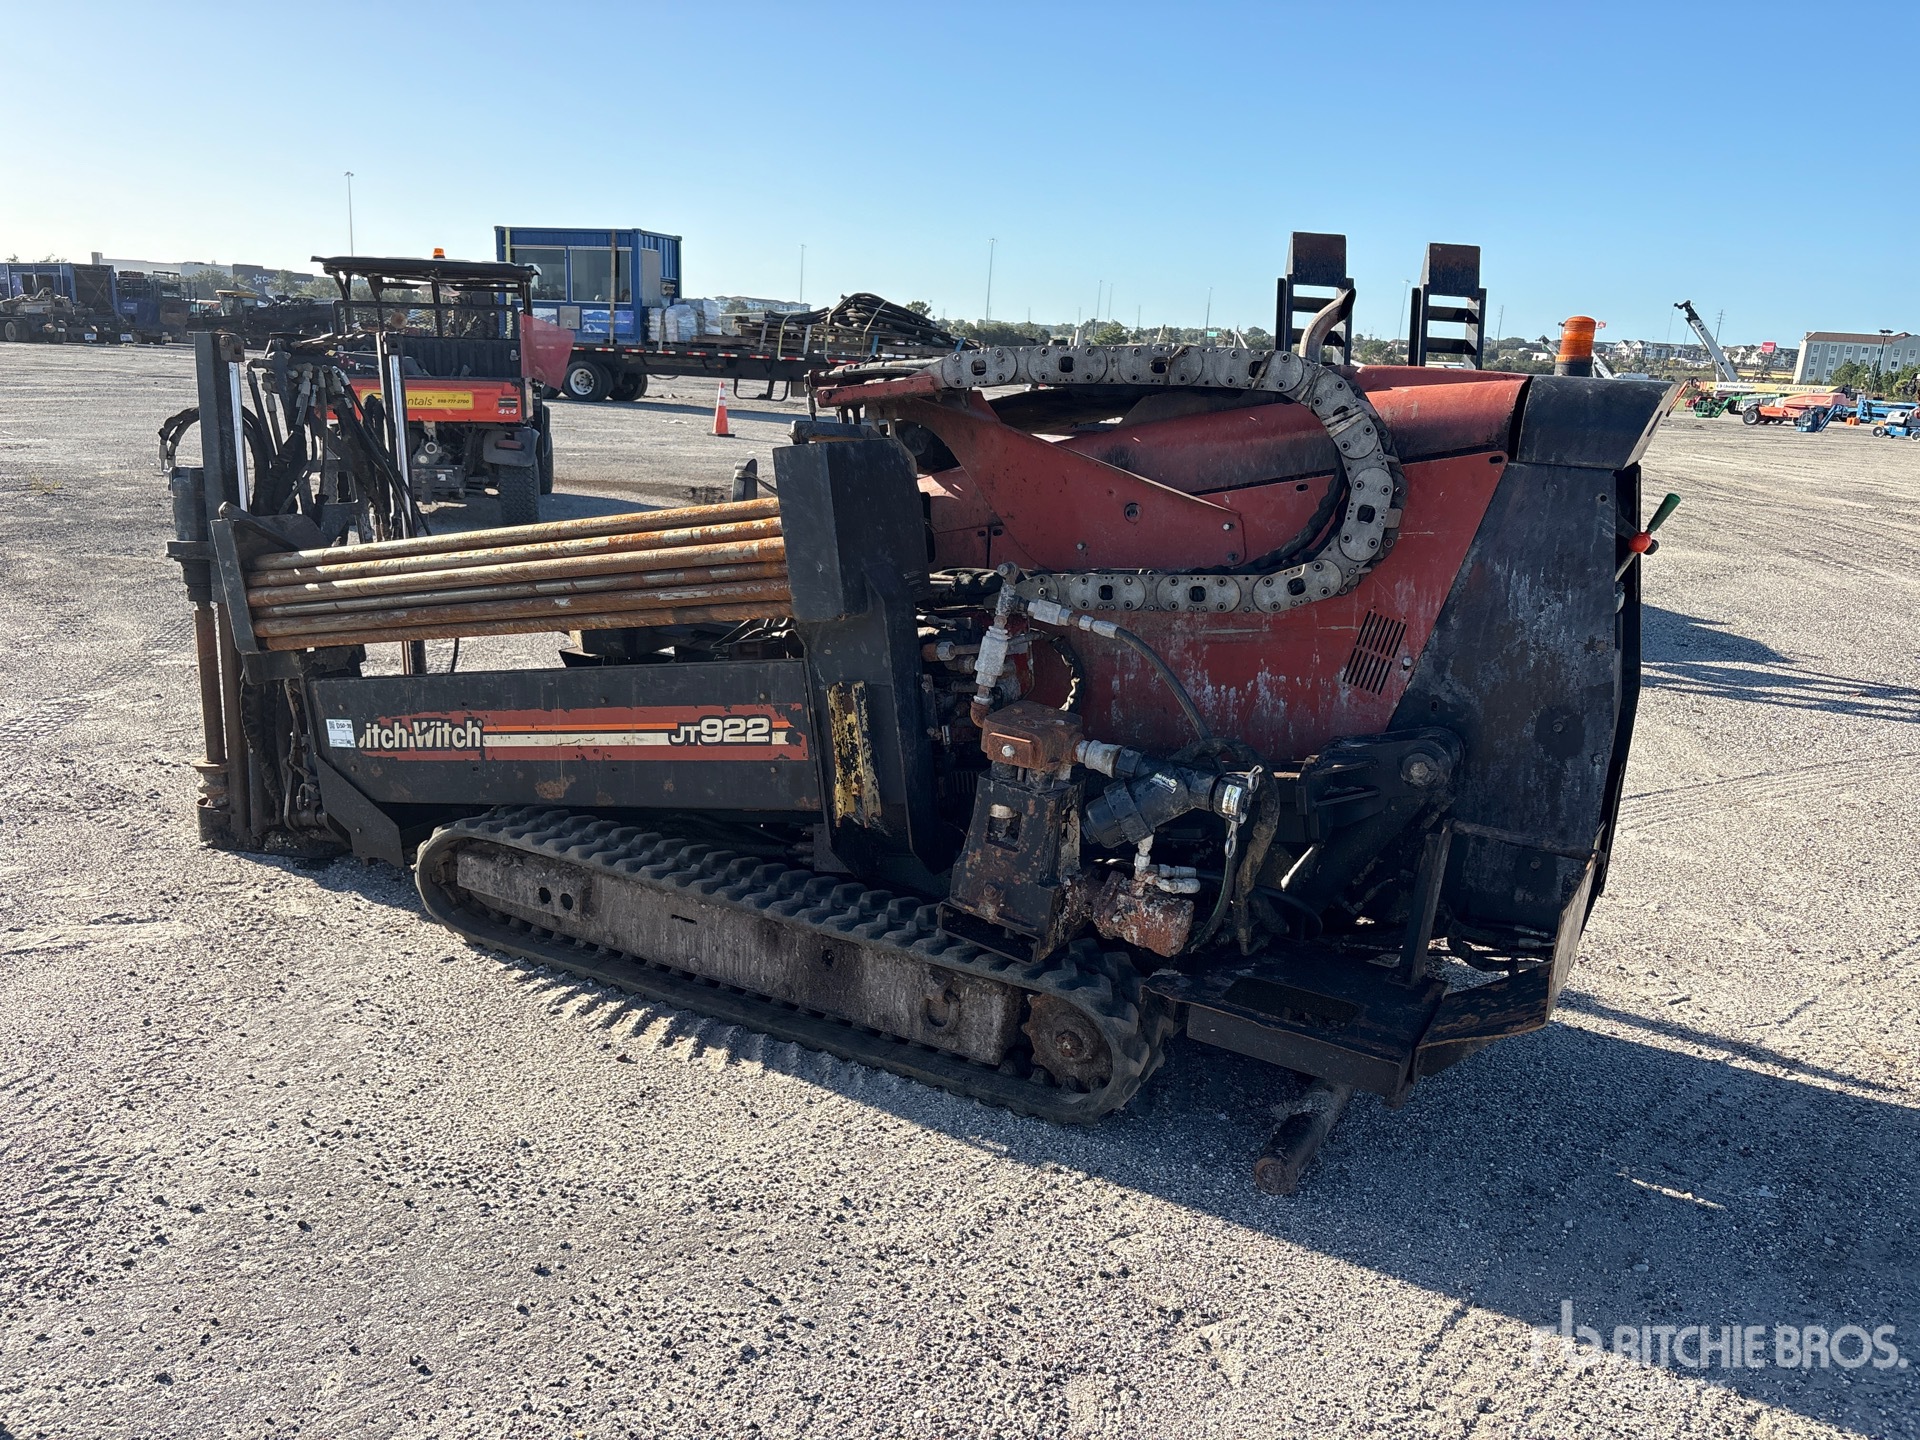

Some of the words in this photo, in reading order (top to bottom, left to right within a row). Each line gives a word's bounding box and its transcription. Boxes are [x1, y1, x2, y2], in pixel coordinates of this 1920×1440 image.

[358, 721, 408, 749] itch
[413, 720, 481, 748] Witch
[671, 717, 770, 743] JT922
